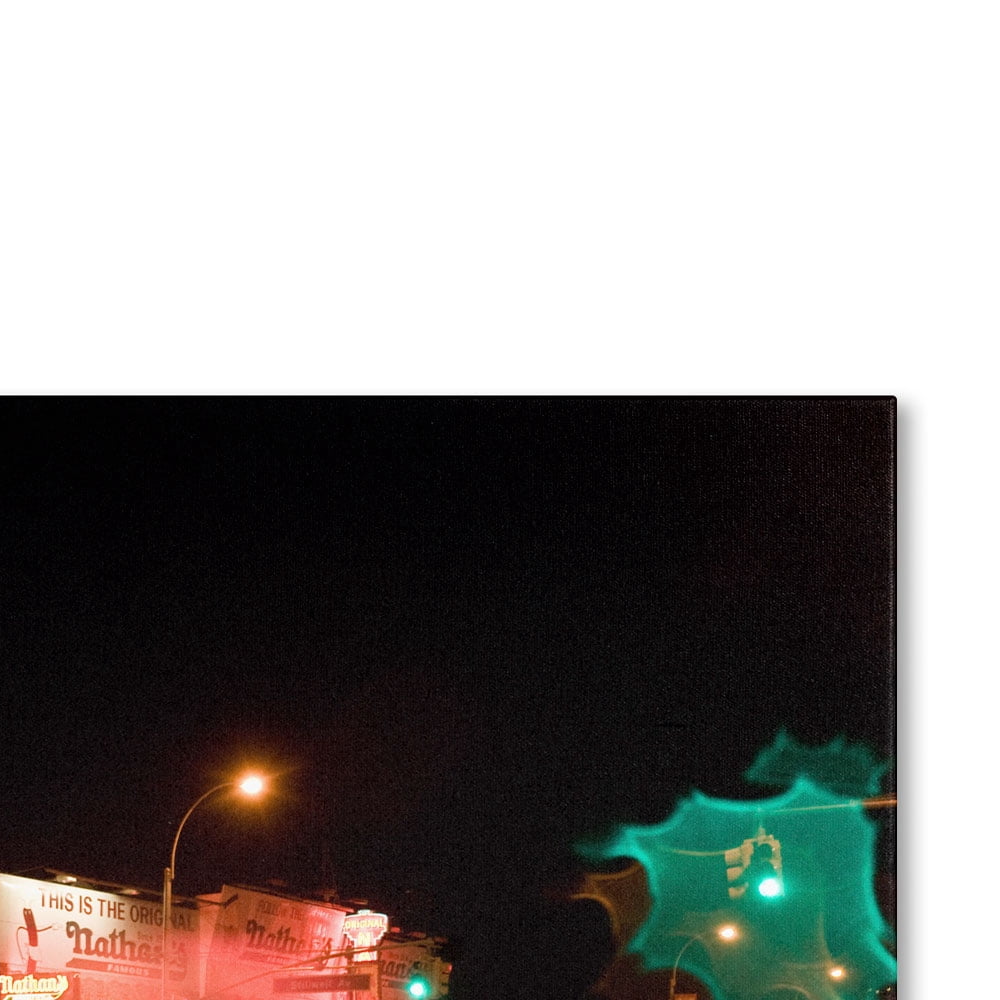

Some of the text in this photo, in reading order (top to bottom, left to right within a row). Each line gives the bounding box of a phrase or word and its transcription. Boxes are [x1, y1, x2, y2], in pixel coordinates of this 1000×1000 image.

[38, 887, 74, 912] THIS
[78, 895, 92, 915] IS
[97, 898, 125, 919] THE
[106, 963, 150, 977] FAMOUS
[0, 974, 69, 994] Nathan's
